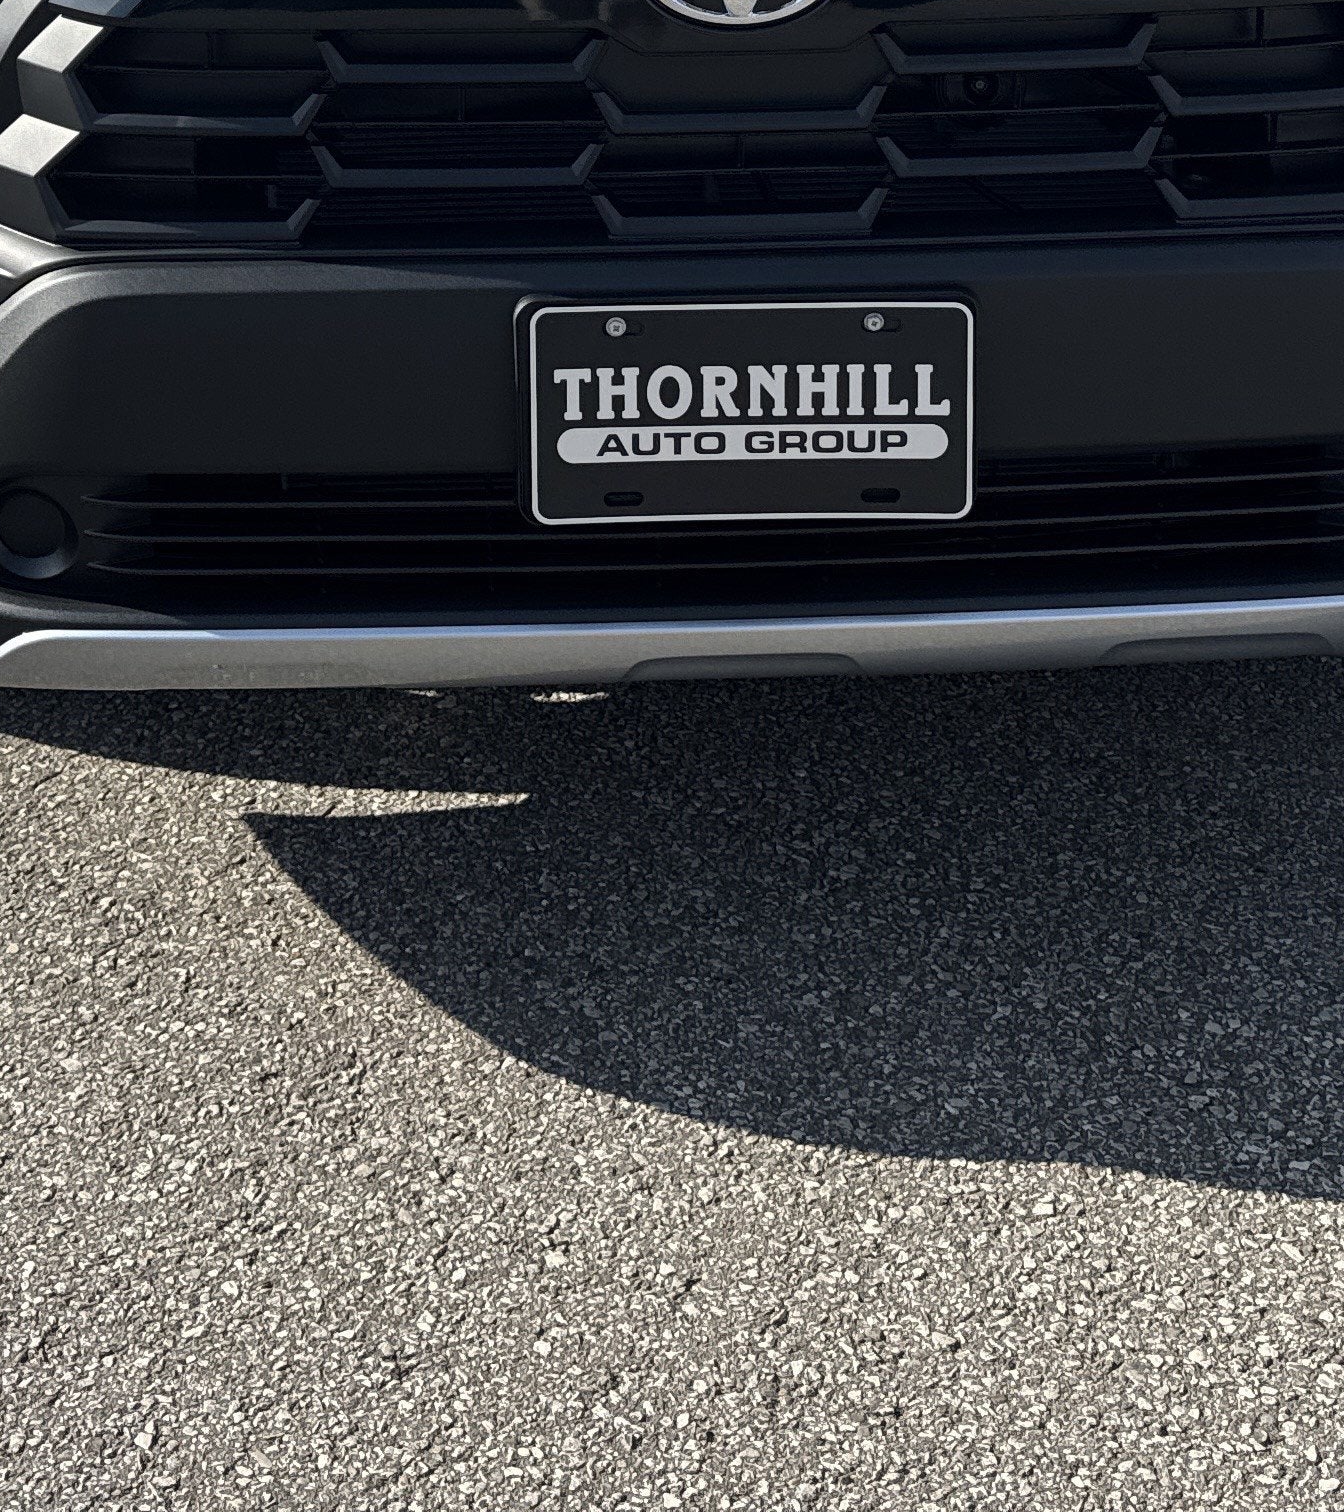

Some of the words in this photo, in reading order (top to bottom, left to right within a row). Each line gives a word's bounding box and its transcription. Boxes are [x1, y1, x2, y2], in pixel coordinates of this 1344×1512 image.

[553, 364, 951, 420] THORNHILL
[596, 431, 726, 457] AUTO
[744, 430, 908, 455] GROUP
